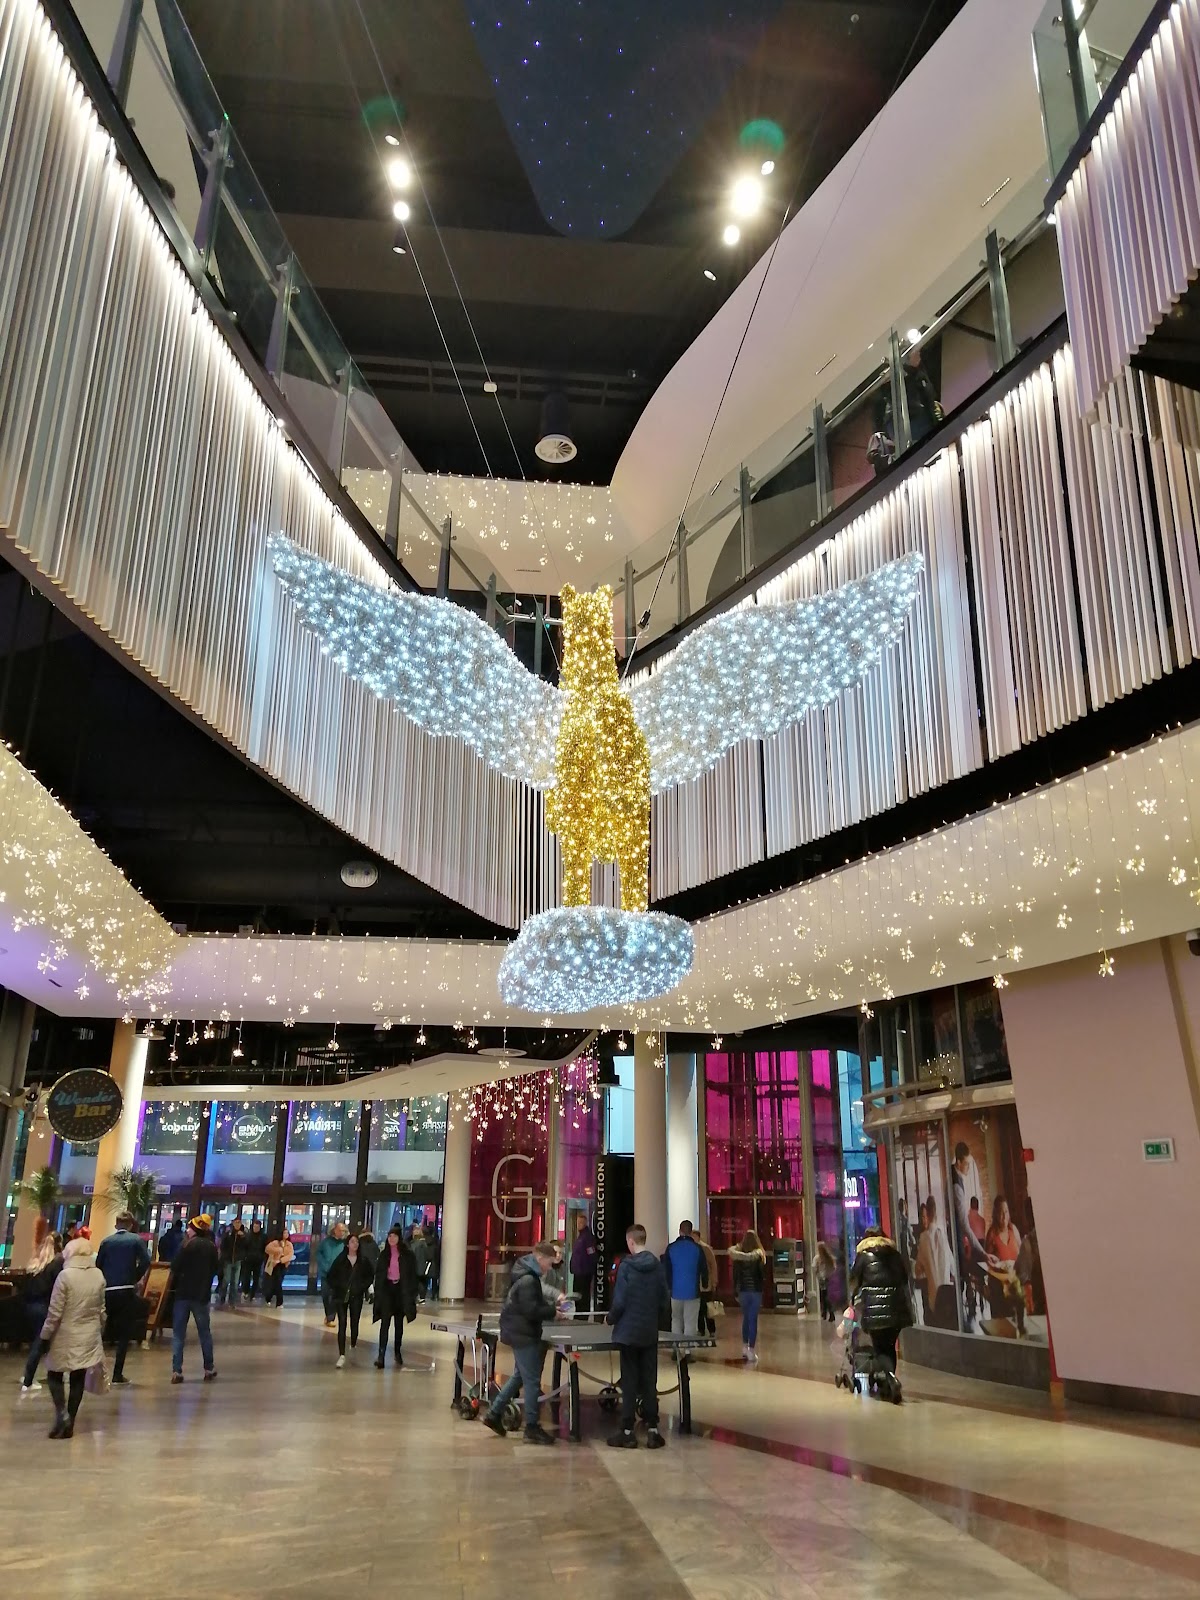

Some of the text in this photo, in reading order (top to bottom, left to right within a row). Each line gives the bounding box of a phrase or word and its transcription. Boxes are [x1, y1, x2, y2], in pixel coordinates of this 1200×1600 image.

[54, 1090, 117, 1106] Wonder
[74, 1104, 112, 1118] Bar
[491, 1153, 535, 1223] G
[597, 1162, 605, 1239] COLLECTION
[596, 1255, 604, 1305] TICKETS
